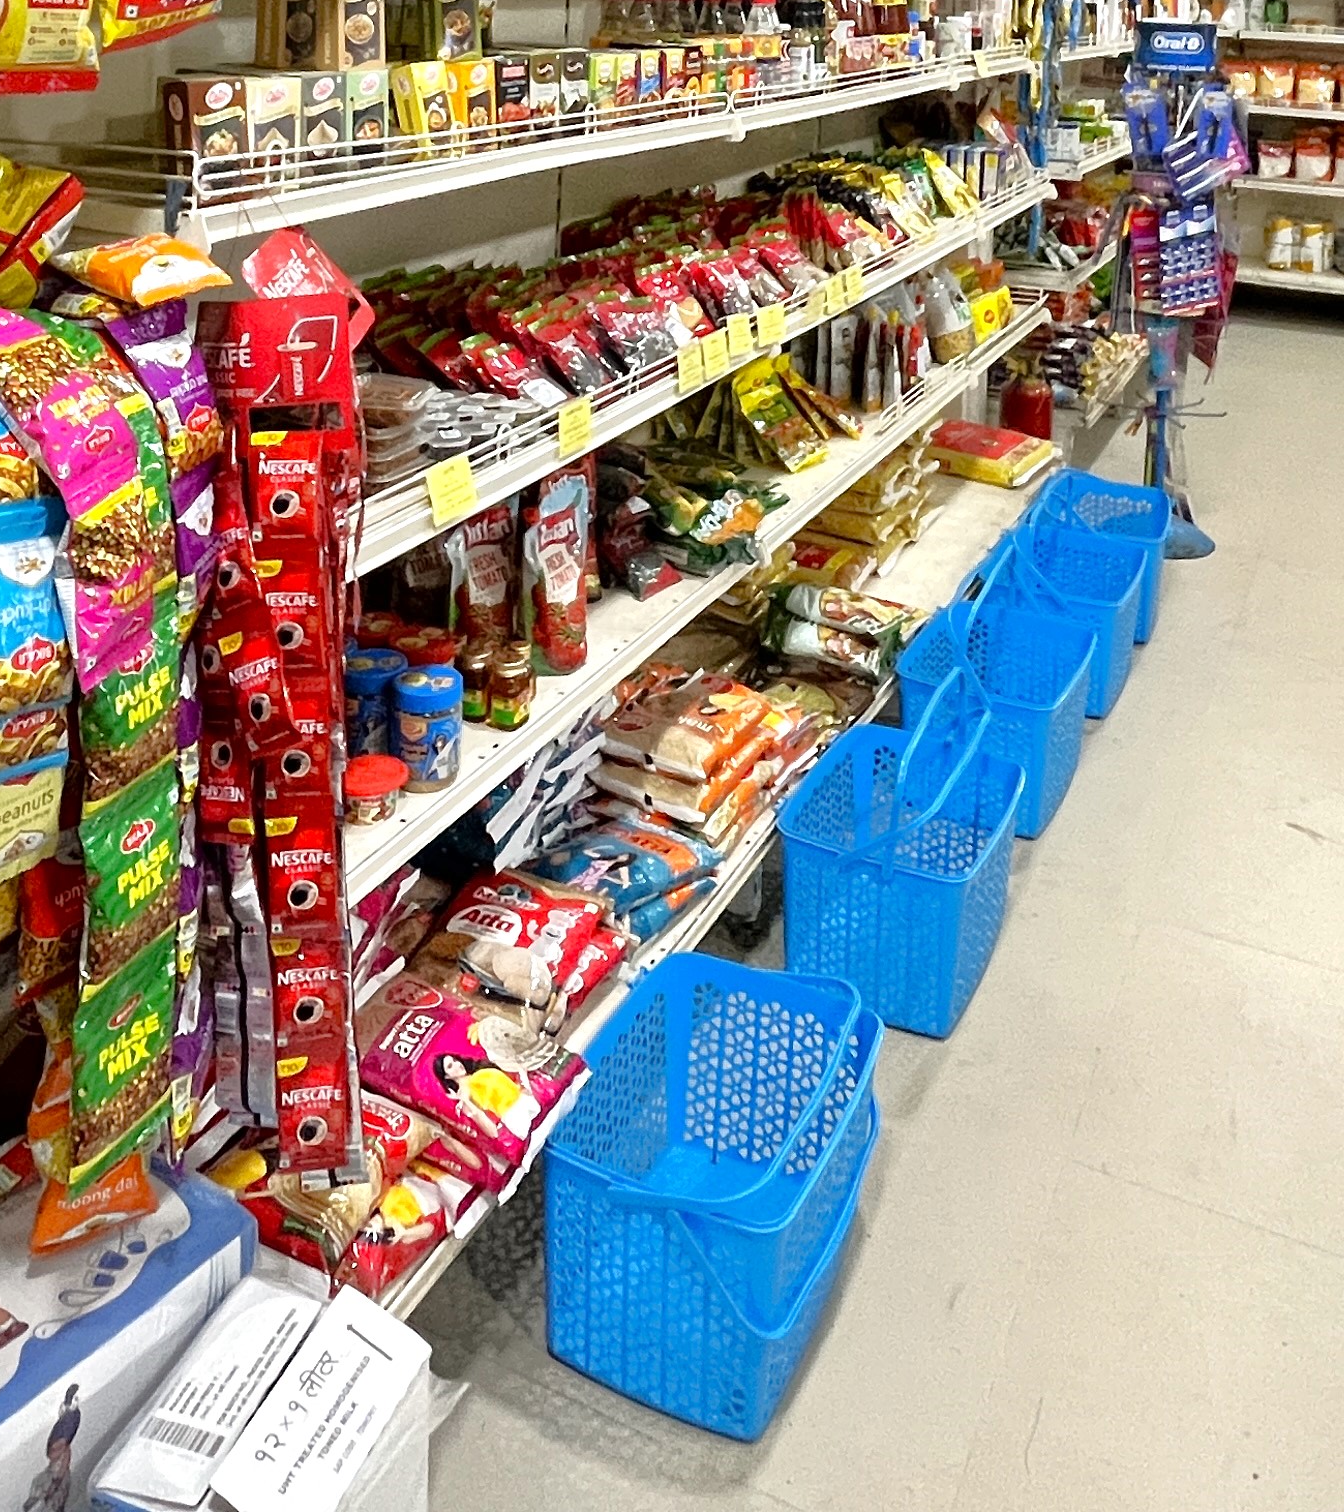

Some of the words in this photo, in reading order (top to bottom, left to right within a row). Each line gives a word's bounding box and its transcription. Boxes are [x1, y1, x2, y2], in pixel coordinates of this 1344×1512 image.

[114, 664, 172, 717] PULSE
[127, 690, 164, 730] MIX
[117, 838, 171, 895] PULSE
[128, 860, 165, 909] MIX
[459, 909, 515, 934] Atta
[97, 1011, 161, 1073] PULSE
[106, 1036, 152, 1086] MIX
[391, 1014, 436, 1060] atta
[293, 1423, 327, 1470] TREATED
